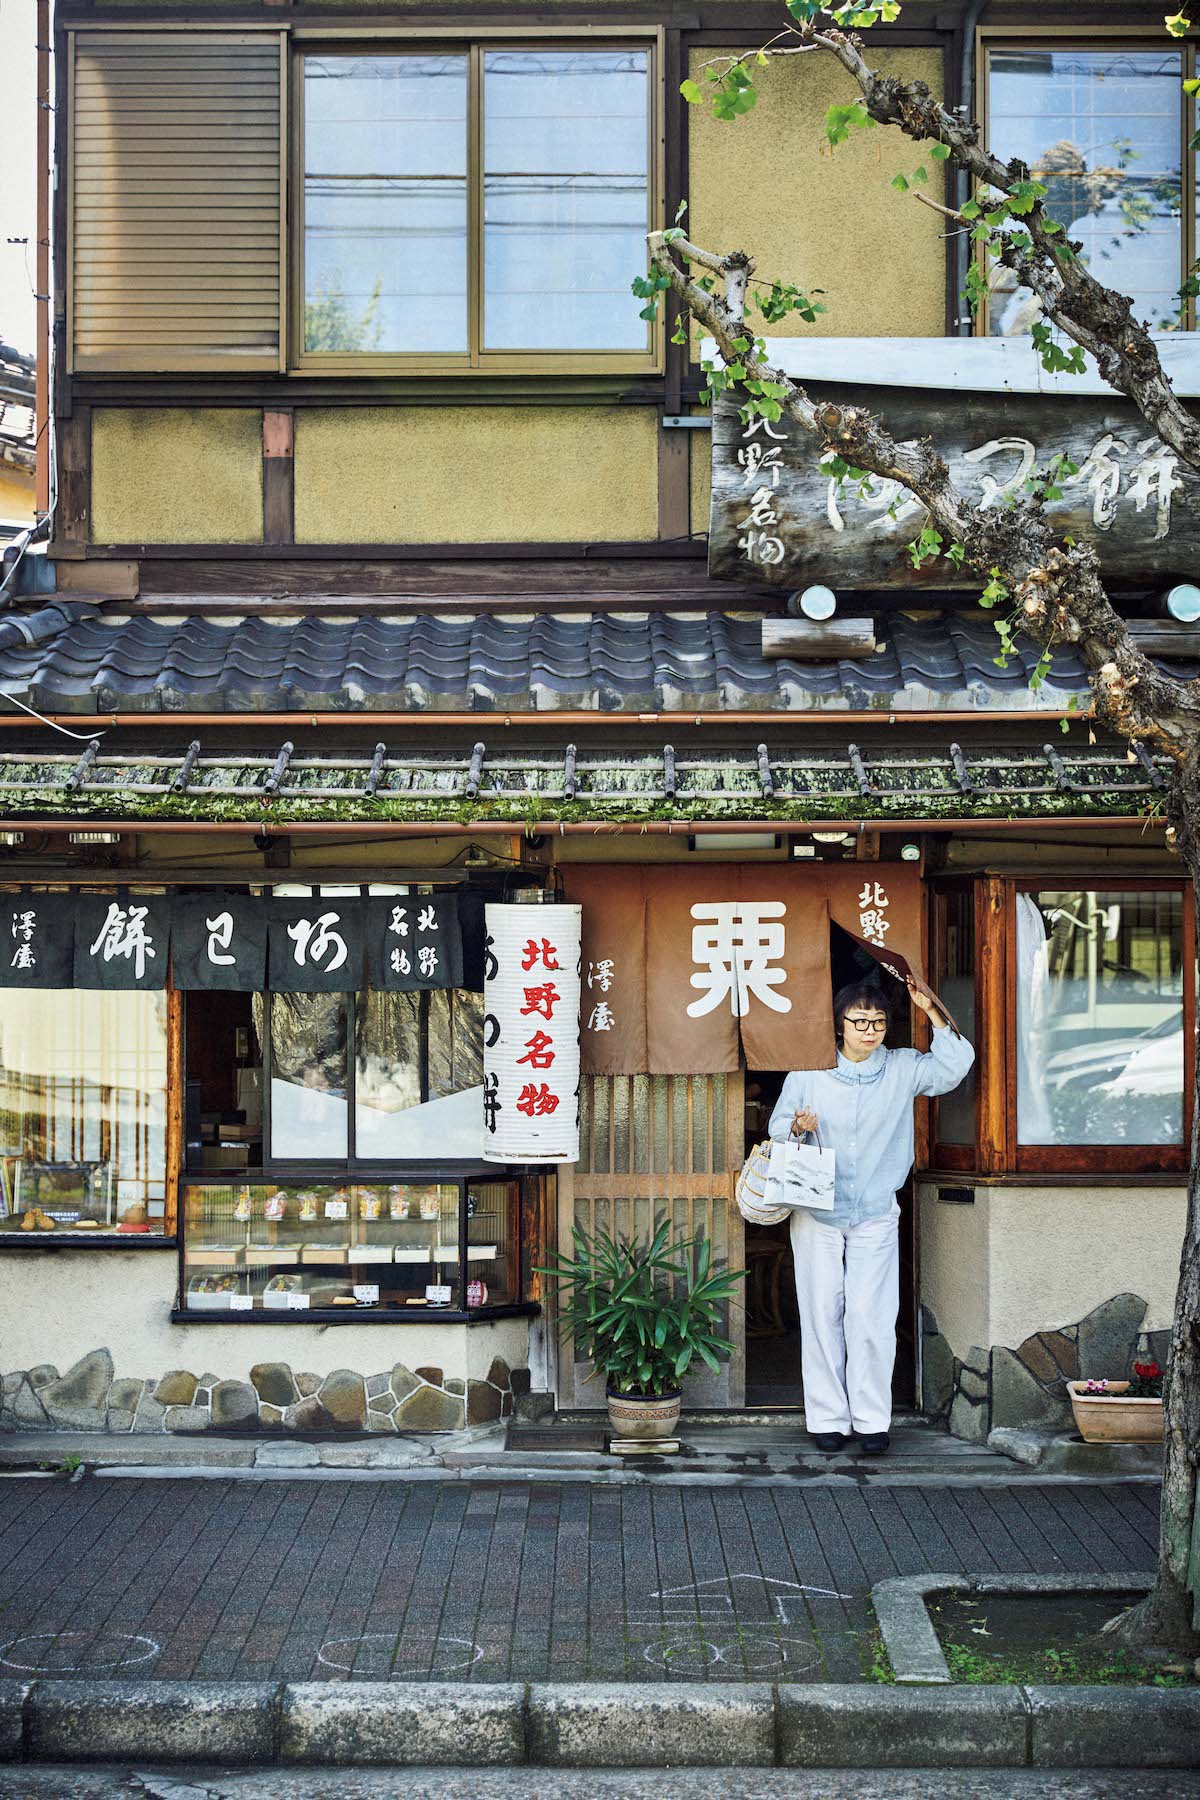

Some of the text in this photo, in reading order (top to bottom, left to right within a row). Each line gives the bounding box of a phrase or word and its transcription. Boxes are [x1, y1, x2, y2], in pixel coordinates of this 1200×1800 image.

[858, 882, 890, 948] 北野
[516, 937, 561, 1117] 北野名物
